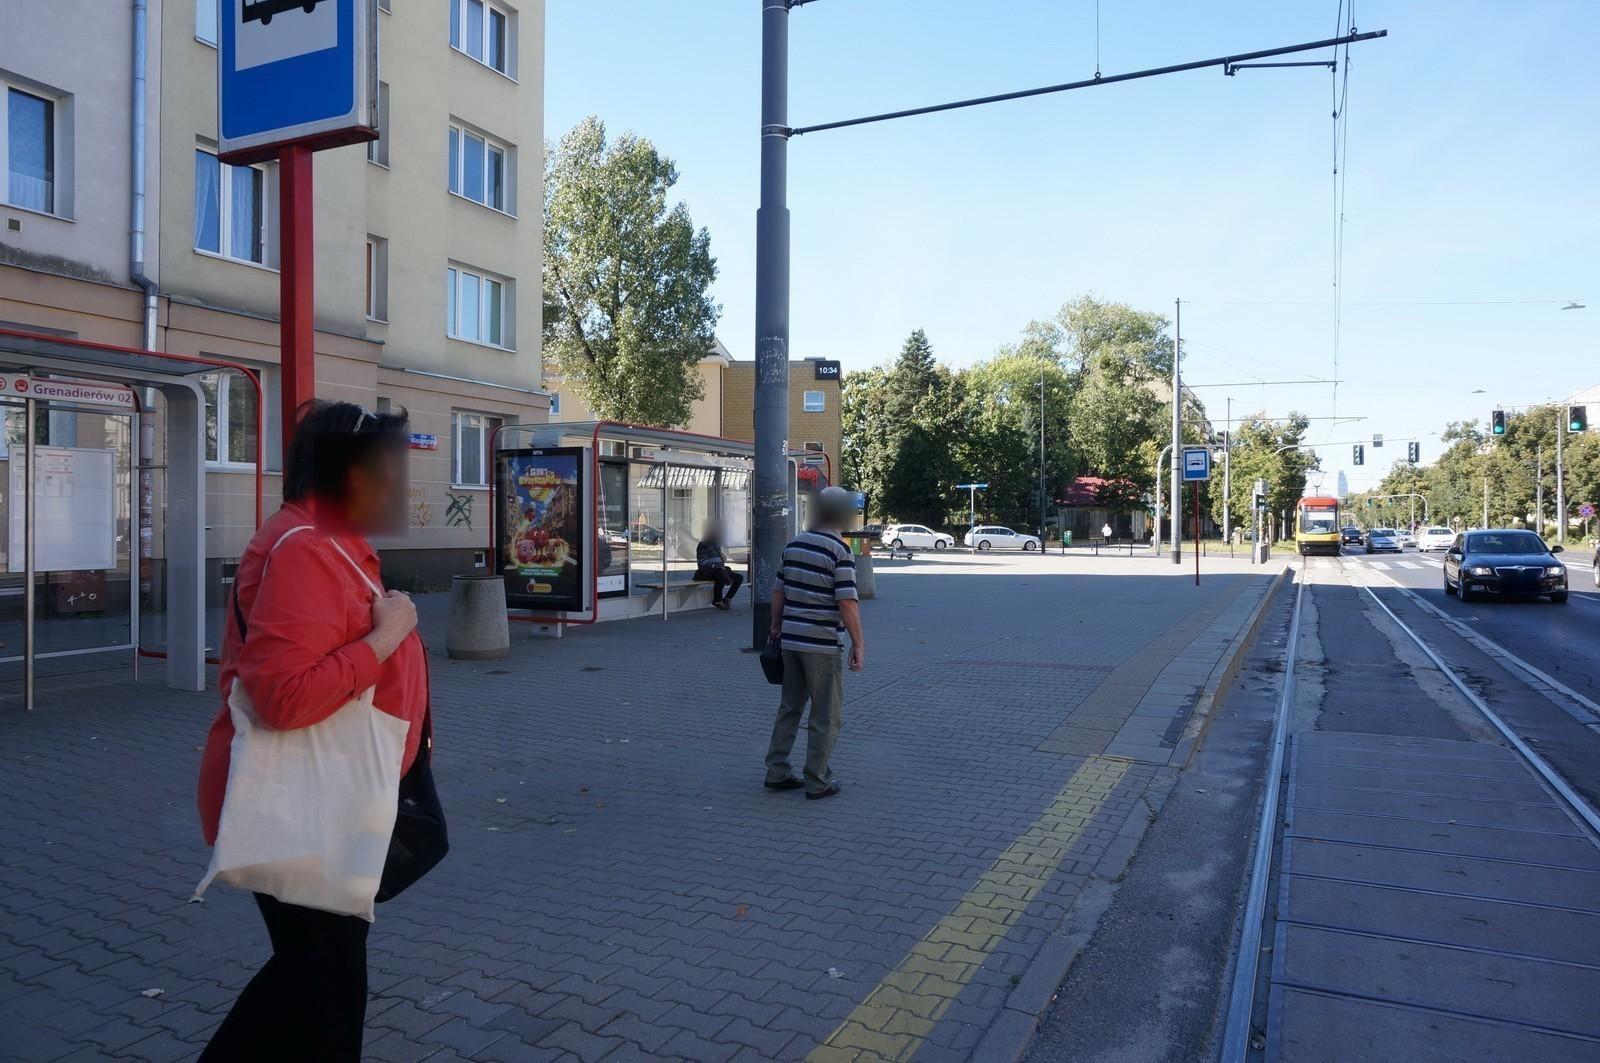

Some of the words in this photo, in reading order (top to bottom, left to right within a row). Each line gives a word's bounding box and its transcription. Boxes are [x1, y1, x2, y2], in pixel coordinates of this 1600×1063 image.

[818, 366, 838, 374] 10:34
[34, 384, 114, 401] Grenadierów
[118, 392, 131, 403] 02
